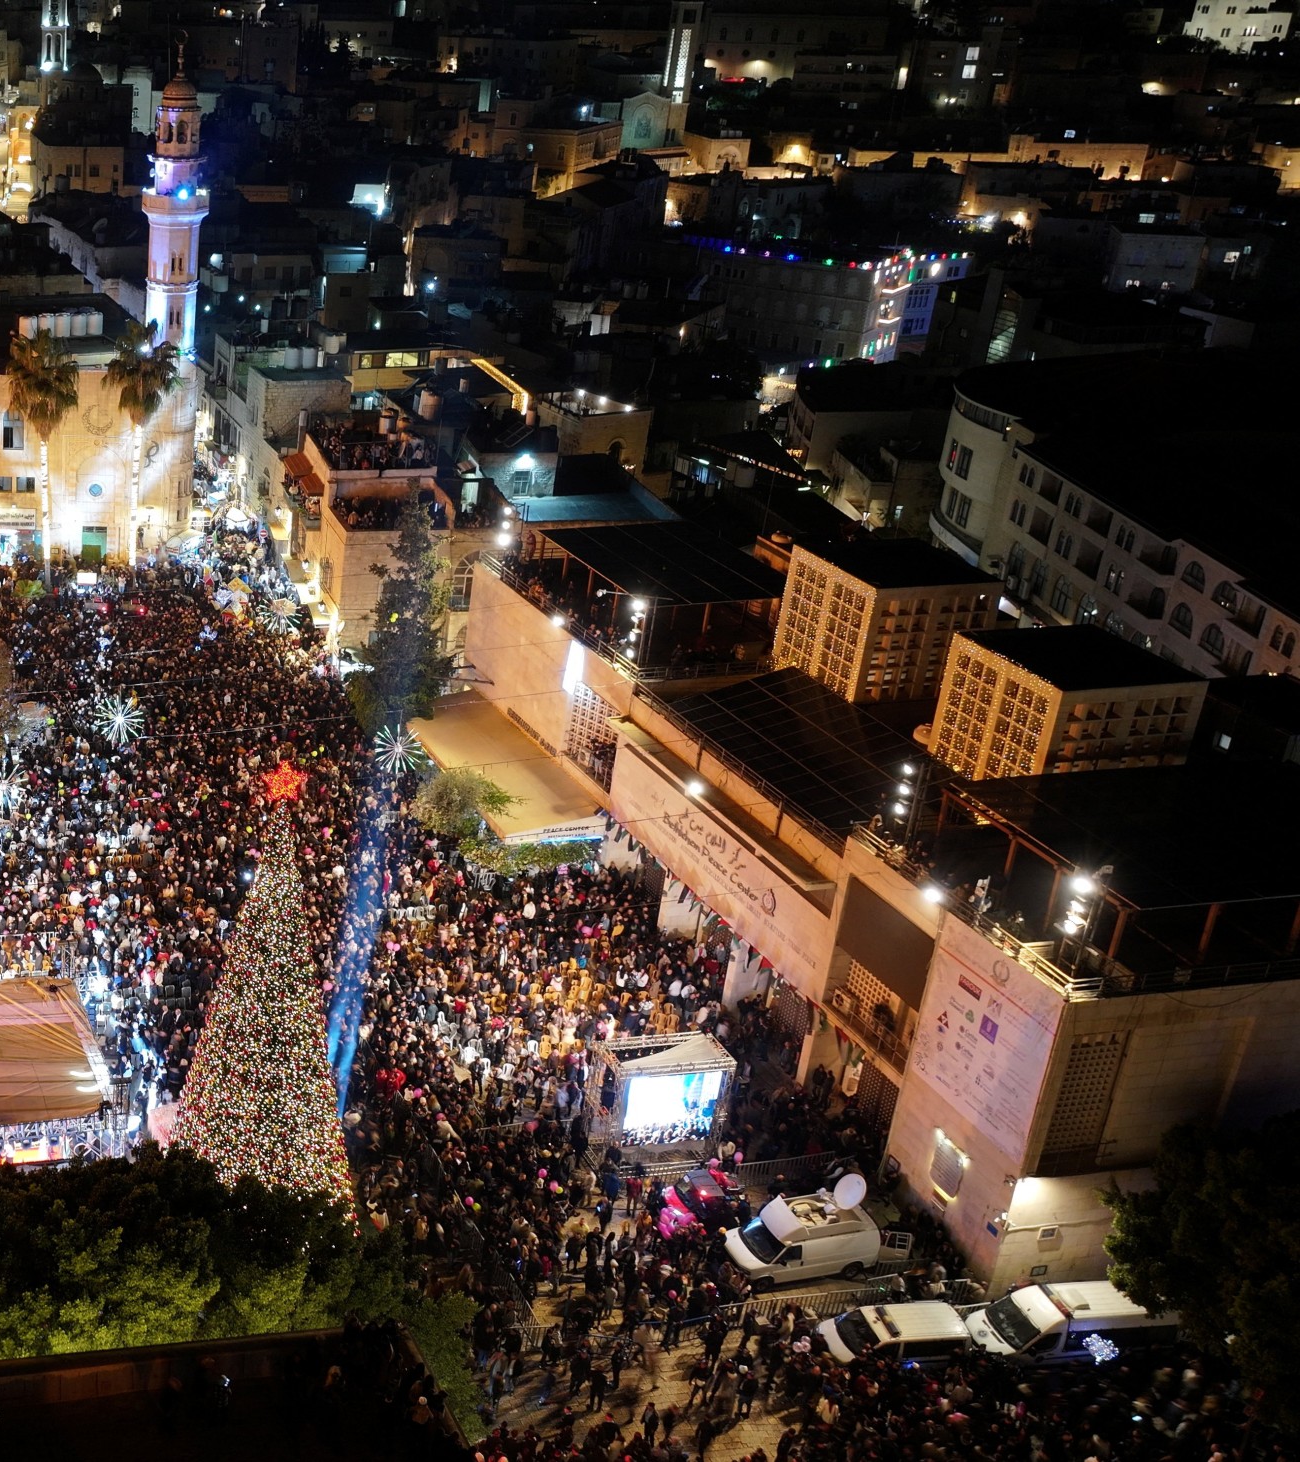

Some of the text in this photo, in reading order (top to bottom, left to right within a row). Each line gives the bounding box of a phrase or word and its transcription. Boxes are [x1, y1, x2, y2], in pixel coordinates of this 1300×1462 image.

[663, 812, 700, 852] Bethlehem
[702, 846, 728, 876] Peace
[730, 872, 758, 900] Center
